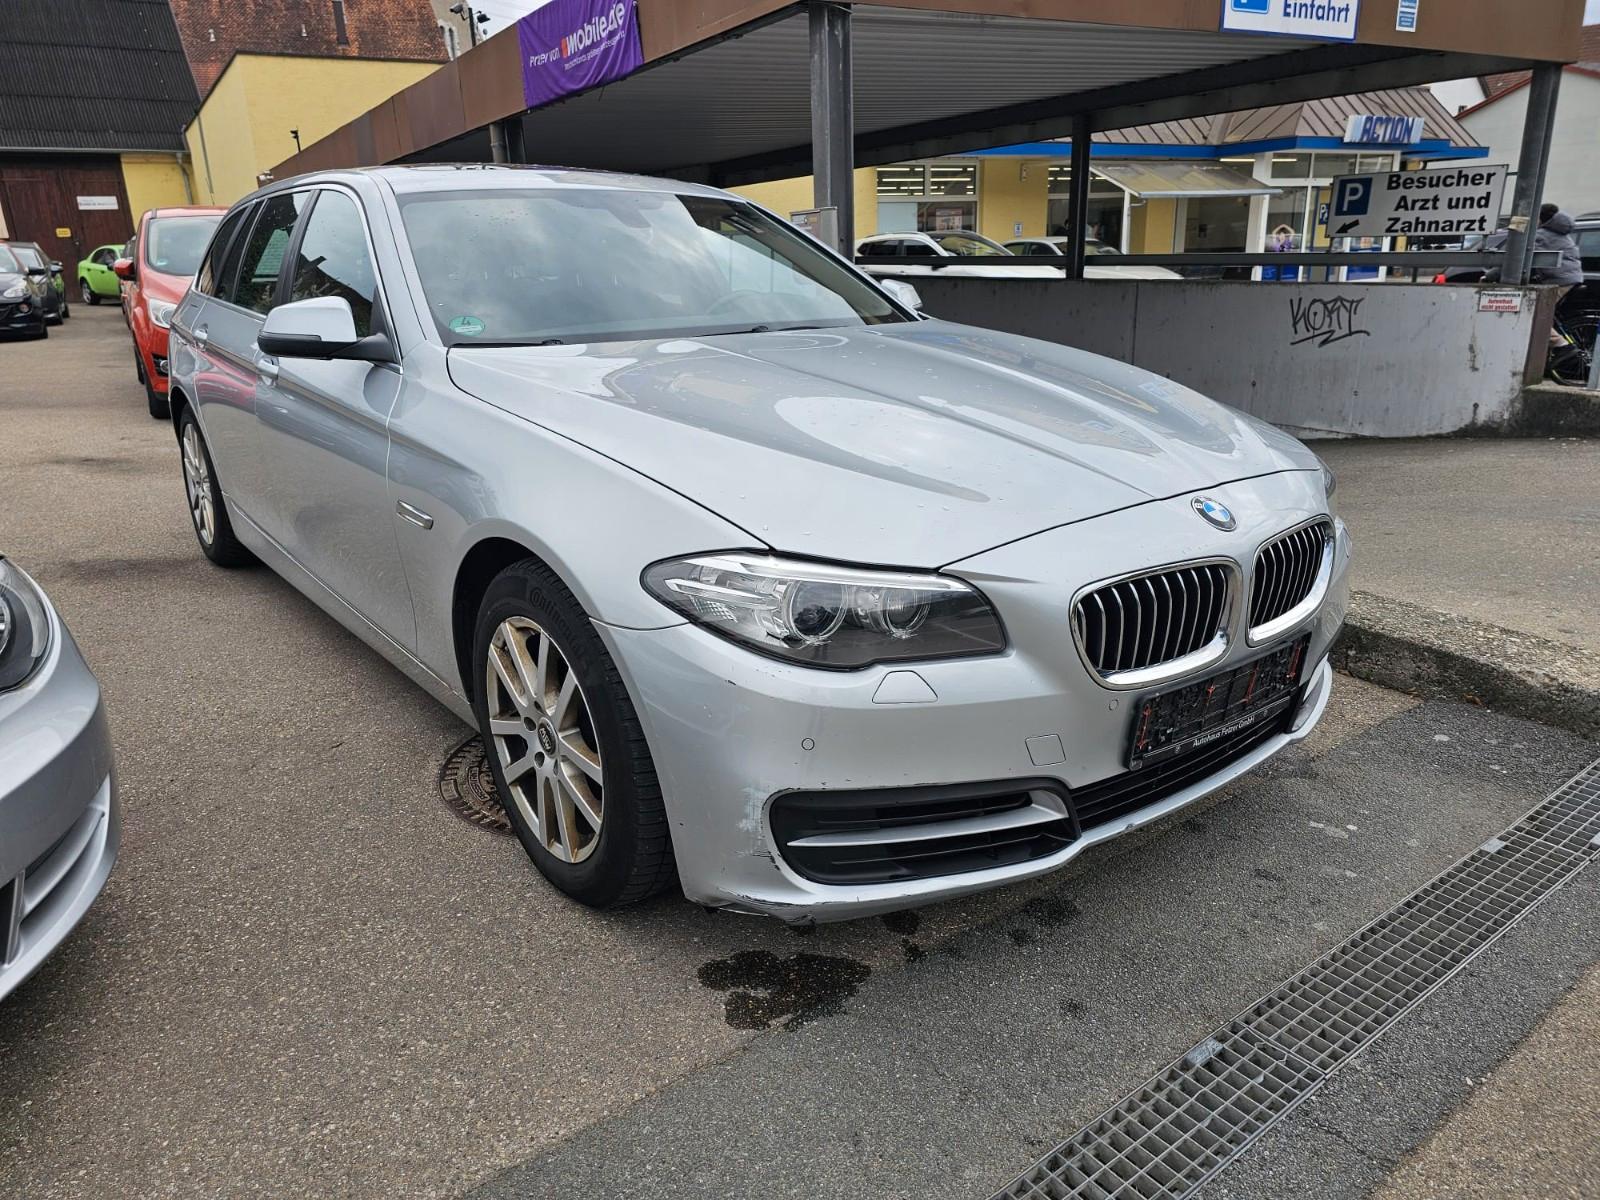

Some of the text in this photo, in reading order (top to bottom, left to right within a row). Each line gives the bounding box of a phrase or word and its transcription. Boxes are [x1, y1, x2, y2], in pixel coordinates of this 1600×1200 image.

[1282, 0, 1350, 23] Einfahrt
[1361, 115, 1415, 143] ACTION
[1386, 170, 1496, 191] Besucher
[1342, 182, 1364, 212] P
[1394, 192, 1492, 212] Arzt und
[1384, 215, 1488, 233] Zahnarzt
[1192, 732, 1221, 748] Autohaus
[1238, 714, 1255, 729] GmbH
